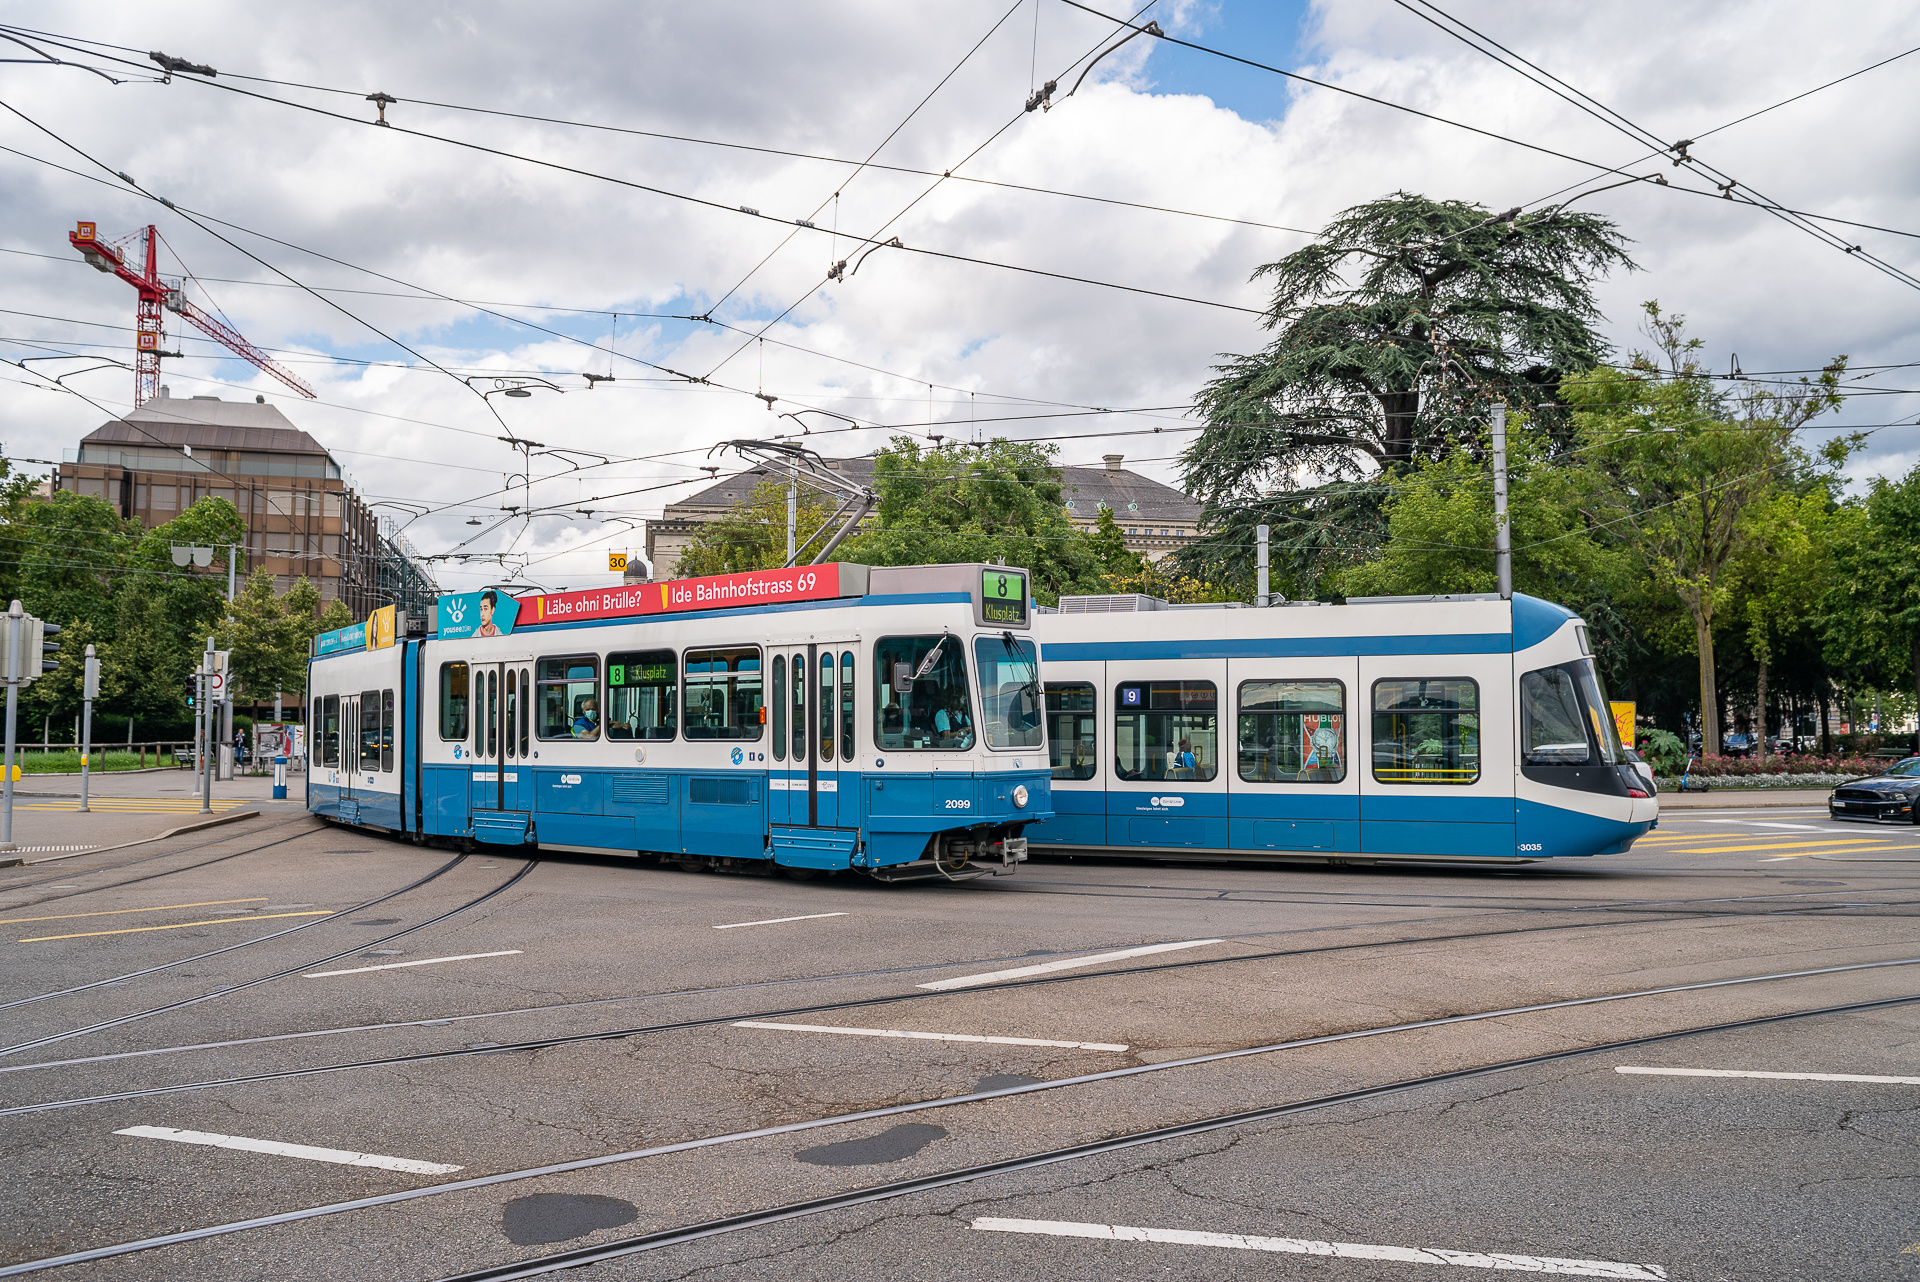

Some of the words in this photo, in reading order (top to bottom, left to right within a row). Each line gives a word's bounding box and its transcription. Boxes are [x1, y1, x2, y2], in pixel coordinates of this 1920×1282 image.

[610, 557, 626, 568] 30
[697, 578, 792, 602] Bahnhofstrass
[797, 572, 817, 592] 69
[997, 574, 1008, 598] 8
[546, 599, 572, 615] Läbe
[575, 596, 600, 613] ohni
[603, 591, 642, 609] Brülle?
[985, 603, 1020, 622] Klusplatz
[614, 668, 621, 682] 8
[635, 665, 667, 681] Klusplatz
[1128, 690, 1136, 702] 9
[1303, 714, 1341, 723] HUBLOT
[945, 799, 971, 809] 2099
[1520, 843, 1542, 852] 3035
